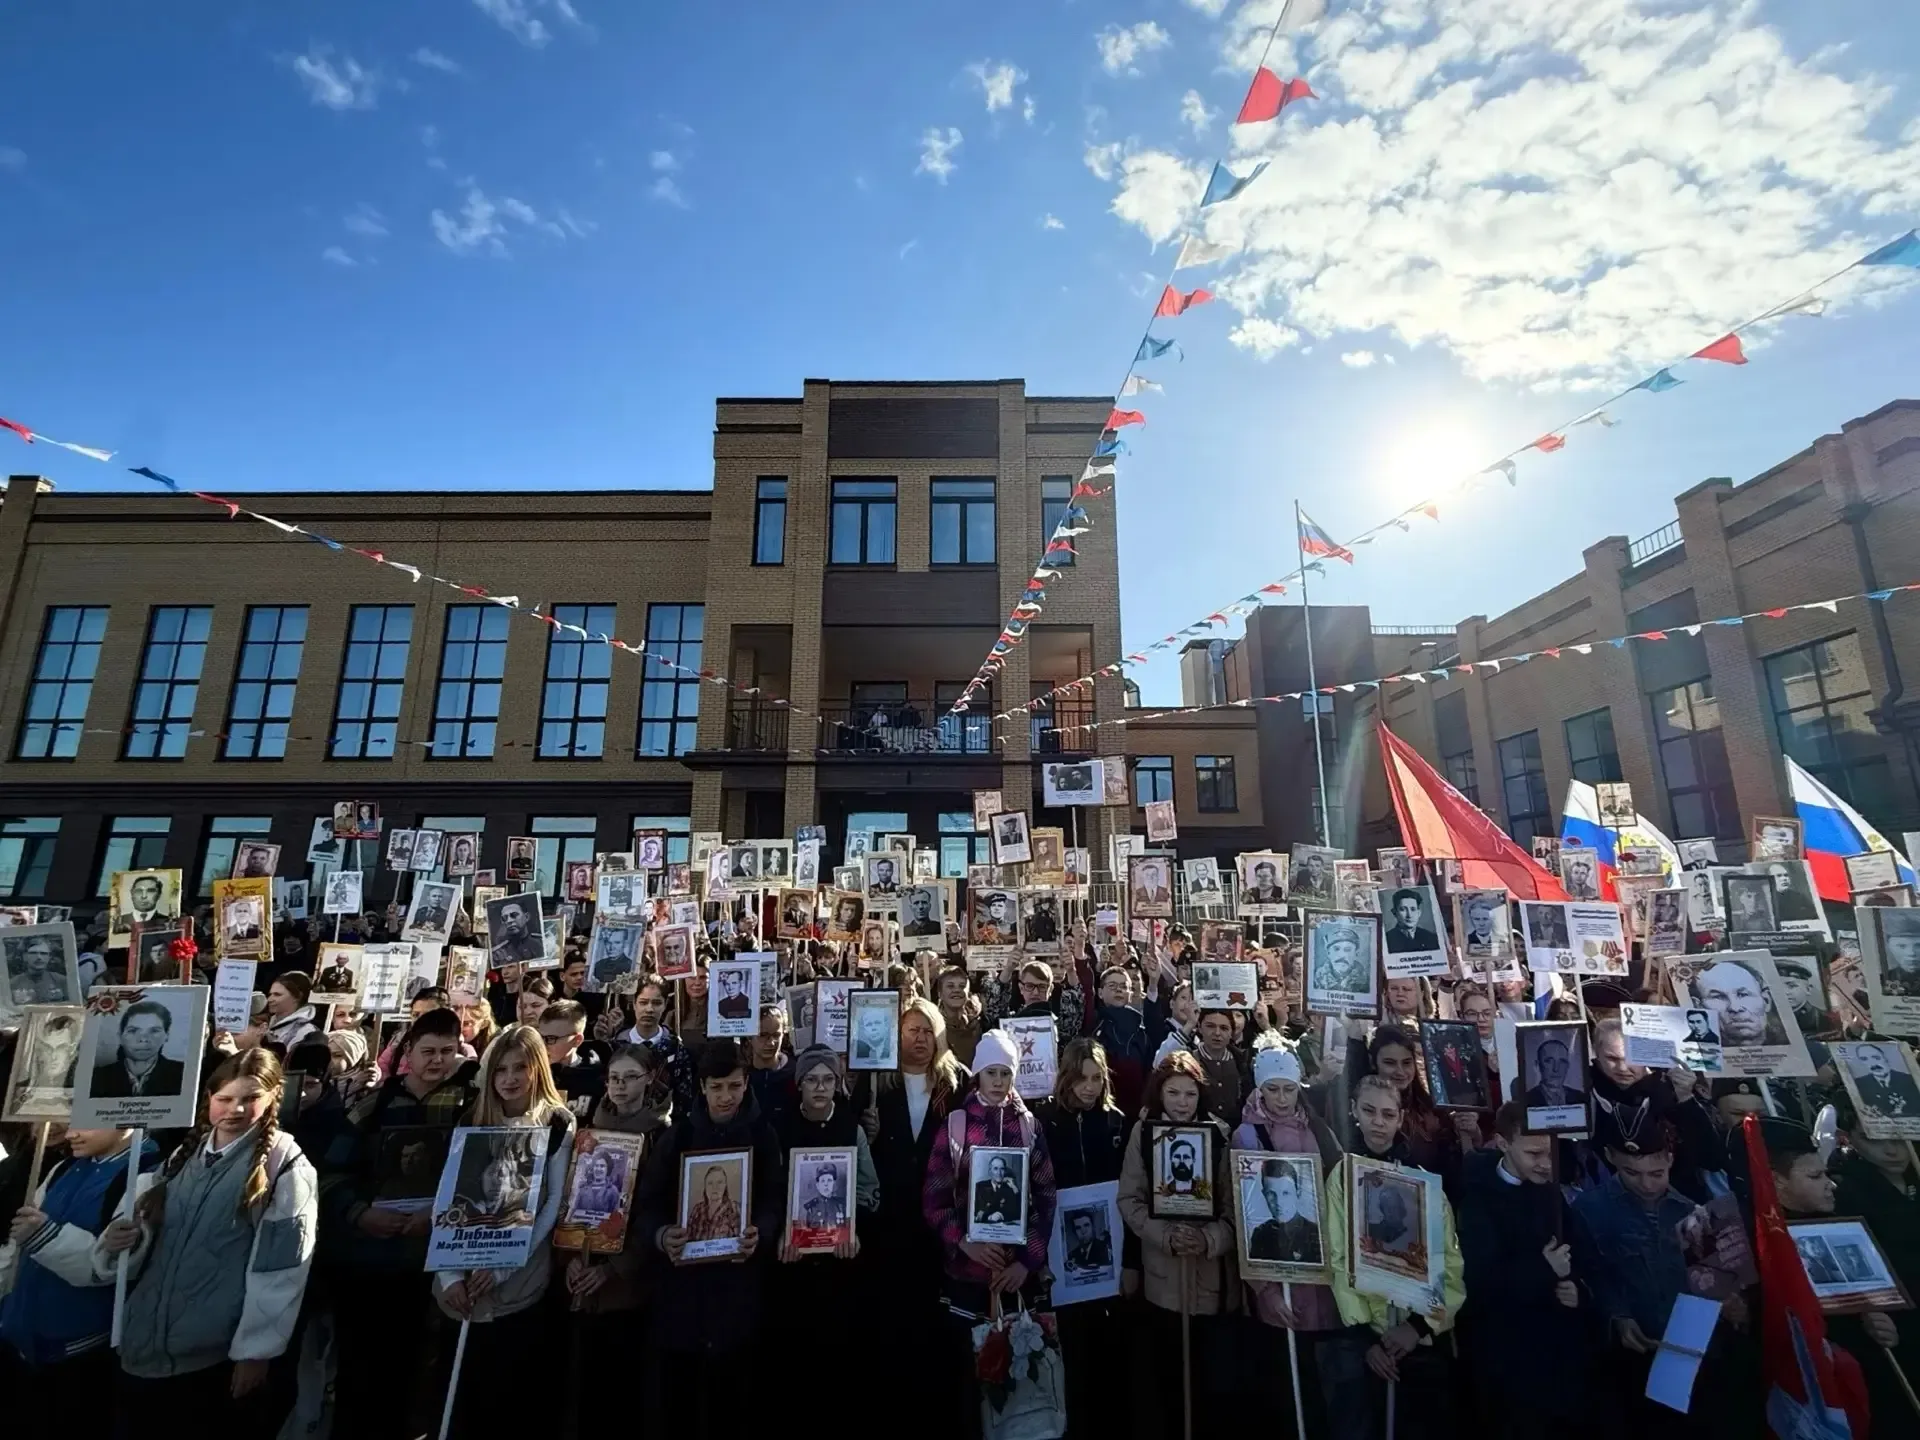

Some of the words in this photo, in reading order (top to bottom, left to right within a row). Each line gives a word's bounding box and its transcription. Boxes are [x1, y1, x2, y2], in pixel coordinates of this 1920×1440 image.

[1019, 1062, 1045, 1076] ПОЛК
[452, 1227, 513, 1241] Либман
[436, 1240, 465, 1252] Марк
[467, 1239, 527, 1249] Шоломович
